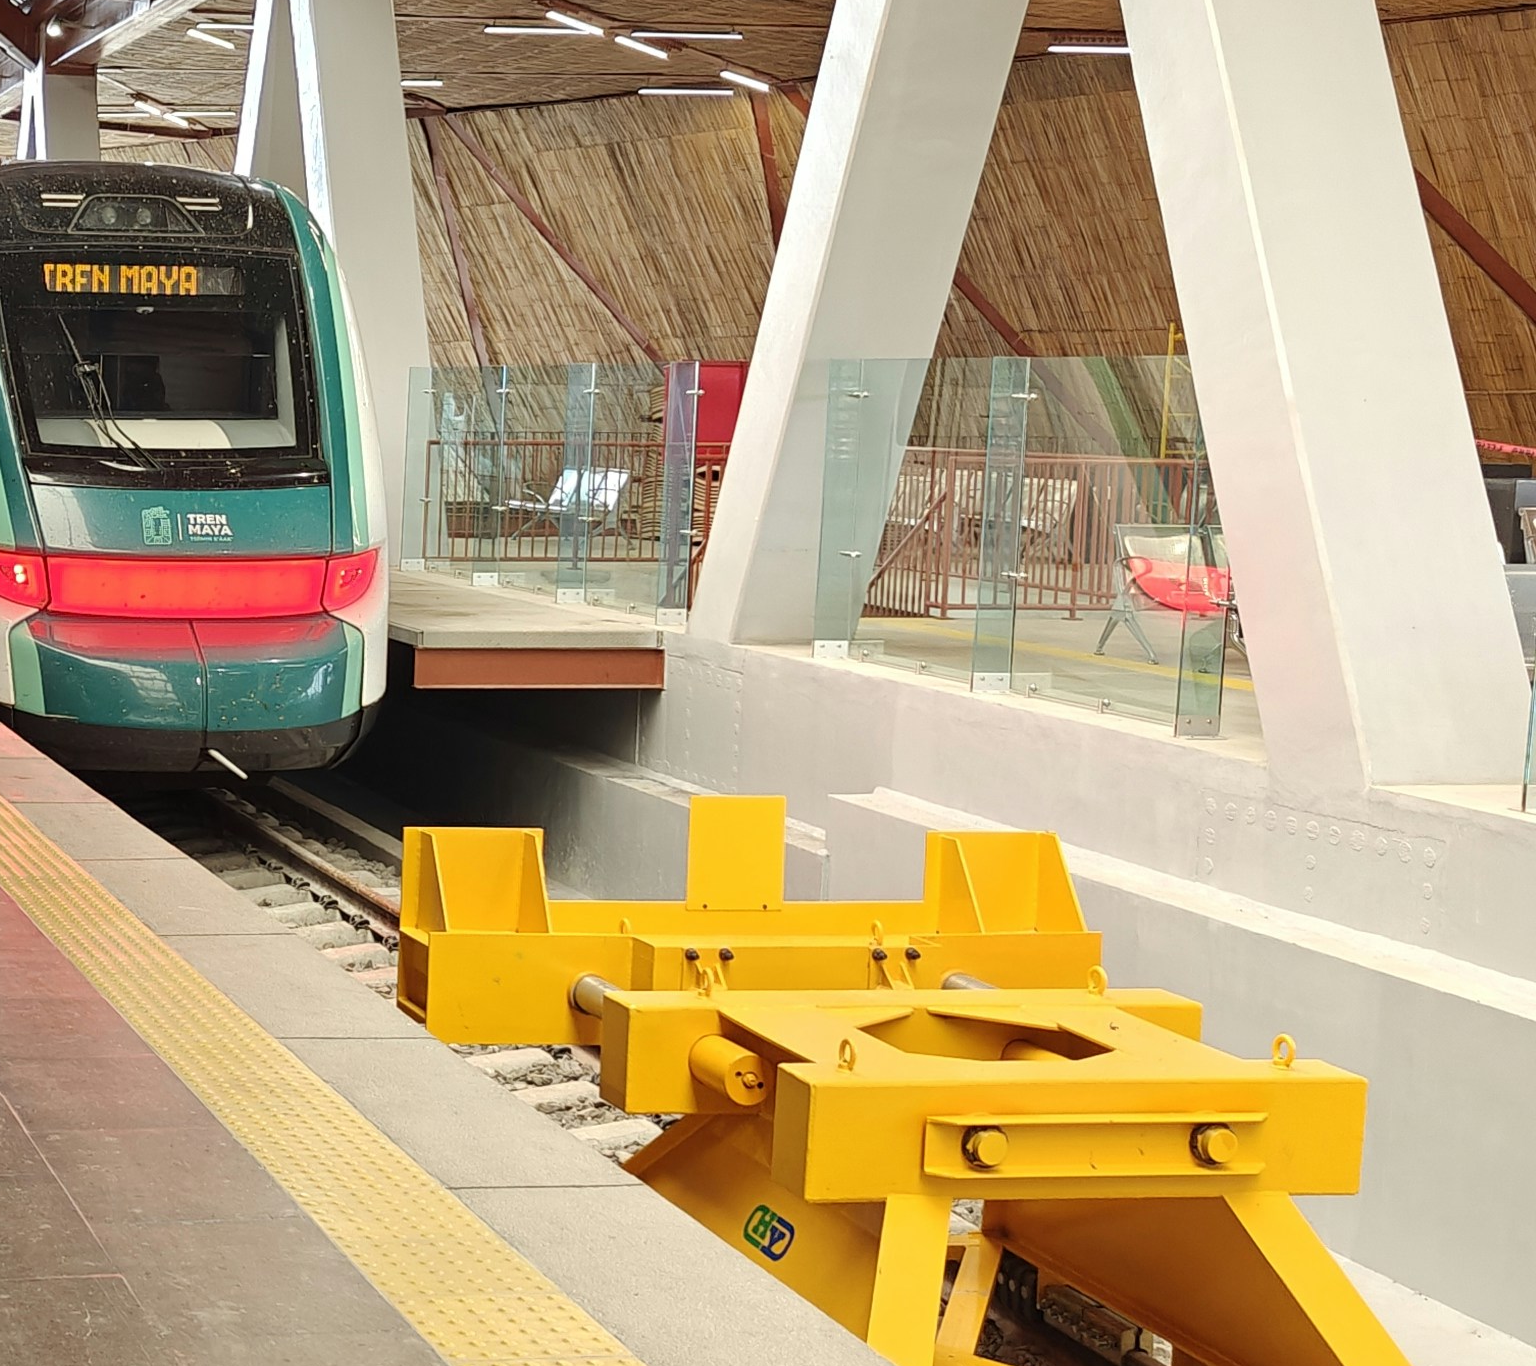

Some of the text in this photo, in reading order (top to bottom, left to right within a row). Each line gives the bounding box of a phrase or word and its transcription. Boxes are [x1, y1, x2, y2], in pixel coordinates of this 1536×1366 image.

[119, 265, 197, 295] MAYA
[187, 514, 227, 525] TREN
[188, 524, 234, 536] MAYA
